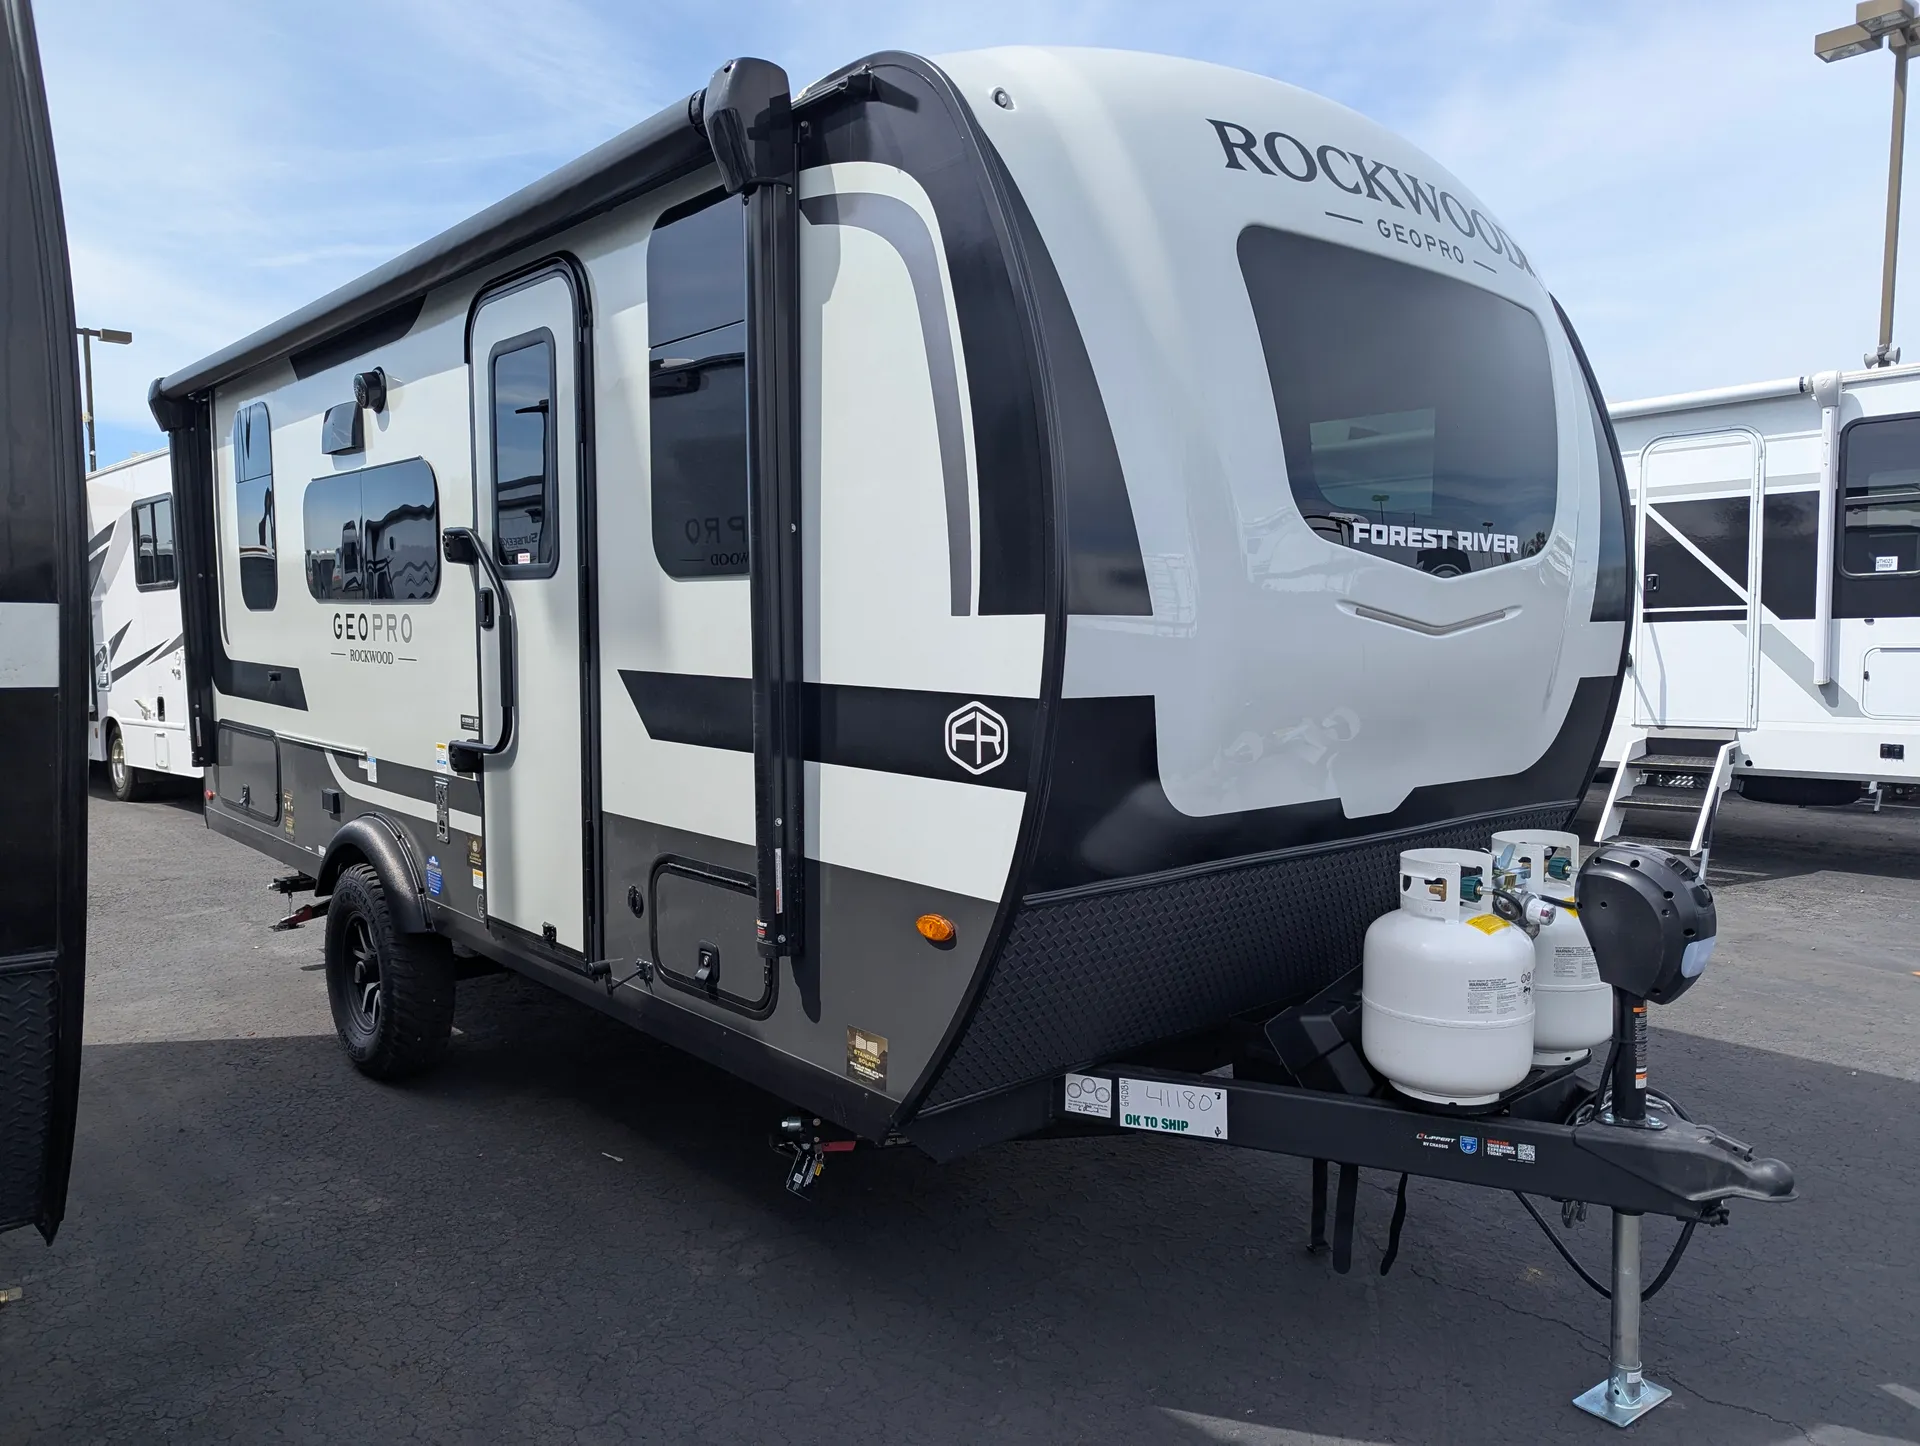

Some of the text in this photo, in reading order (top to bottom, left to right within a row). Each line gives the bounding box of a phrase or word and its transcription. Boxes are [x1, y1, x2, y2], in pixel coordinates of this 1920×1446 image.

[1206, 118, 1535, 278] ROCKWOOD
[1377, 218, 1464, 264] GEOPRO
[1352, 523, 1519, 554] FOREST RIVER
[333, 612, 413, 643] GEOPRO
[349, 649, 394, 665] ROCKWOOD
[853, 1049, 881, 1064] STANDARD
[858, 1057, 876, 1069] SOLAR
[1145, 1085, 1213, 1112] 41180
[1124, 1113, 1189, 1132] OK TO SHIP
[1487, 1147, 1516, 1155] EXPERIENCE
